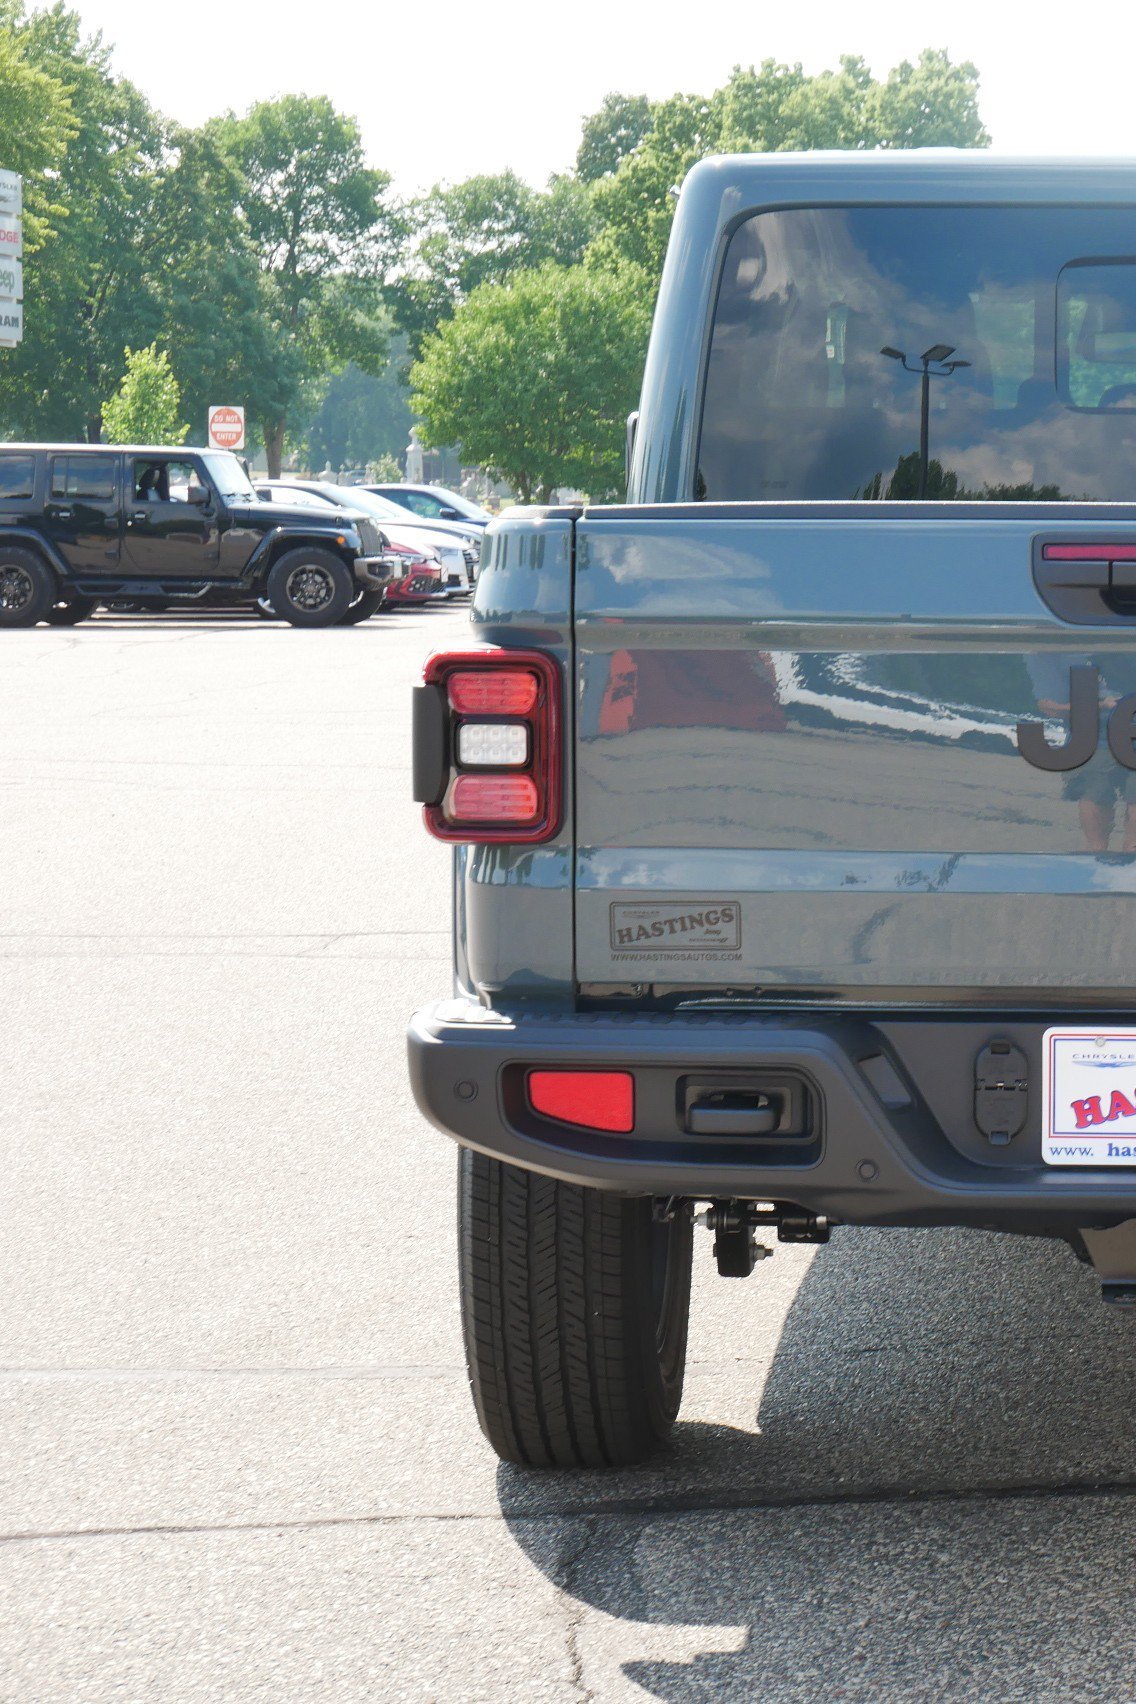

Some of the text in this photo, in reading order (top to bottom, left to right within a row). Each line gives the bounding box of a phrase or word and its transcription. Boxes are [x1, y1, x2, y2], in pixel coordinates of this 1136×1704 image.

[216, 432, 237, 440] ENTER
[616, 907, 735, 944] HASTINGS
[610, 953, 743, 961] WWW.HASTINGSAUTOS.COM
[1049, 1146, 1095, 1156] www.
